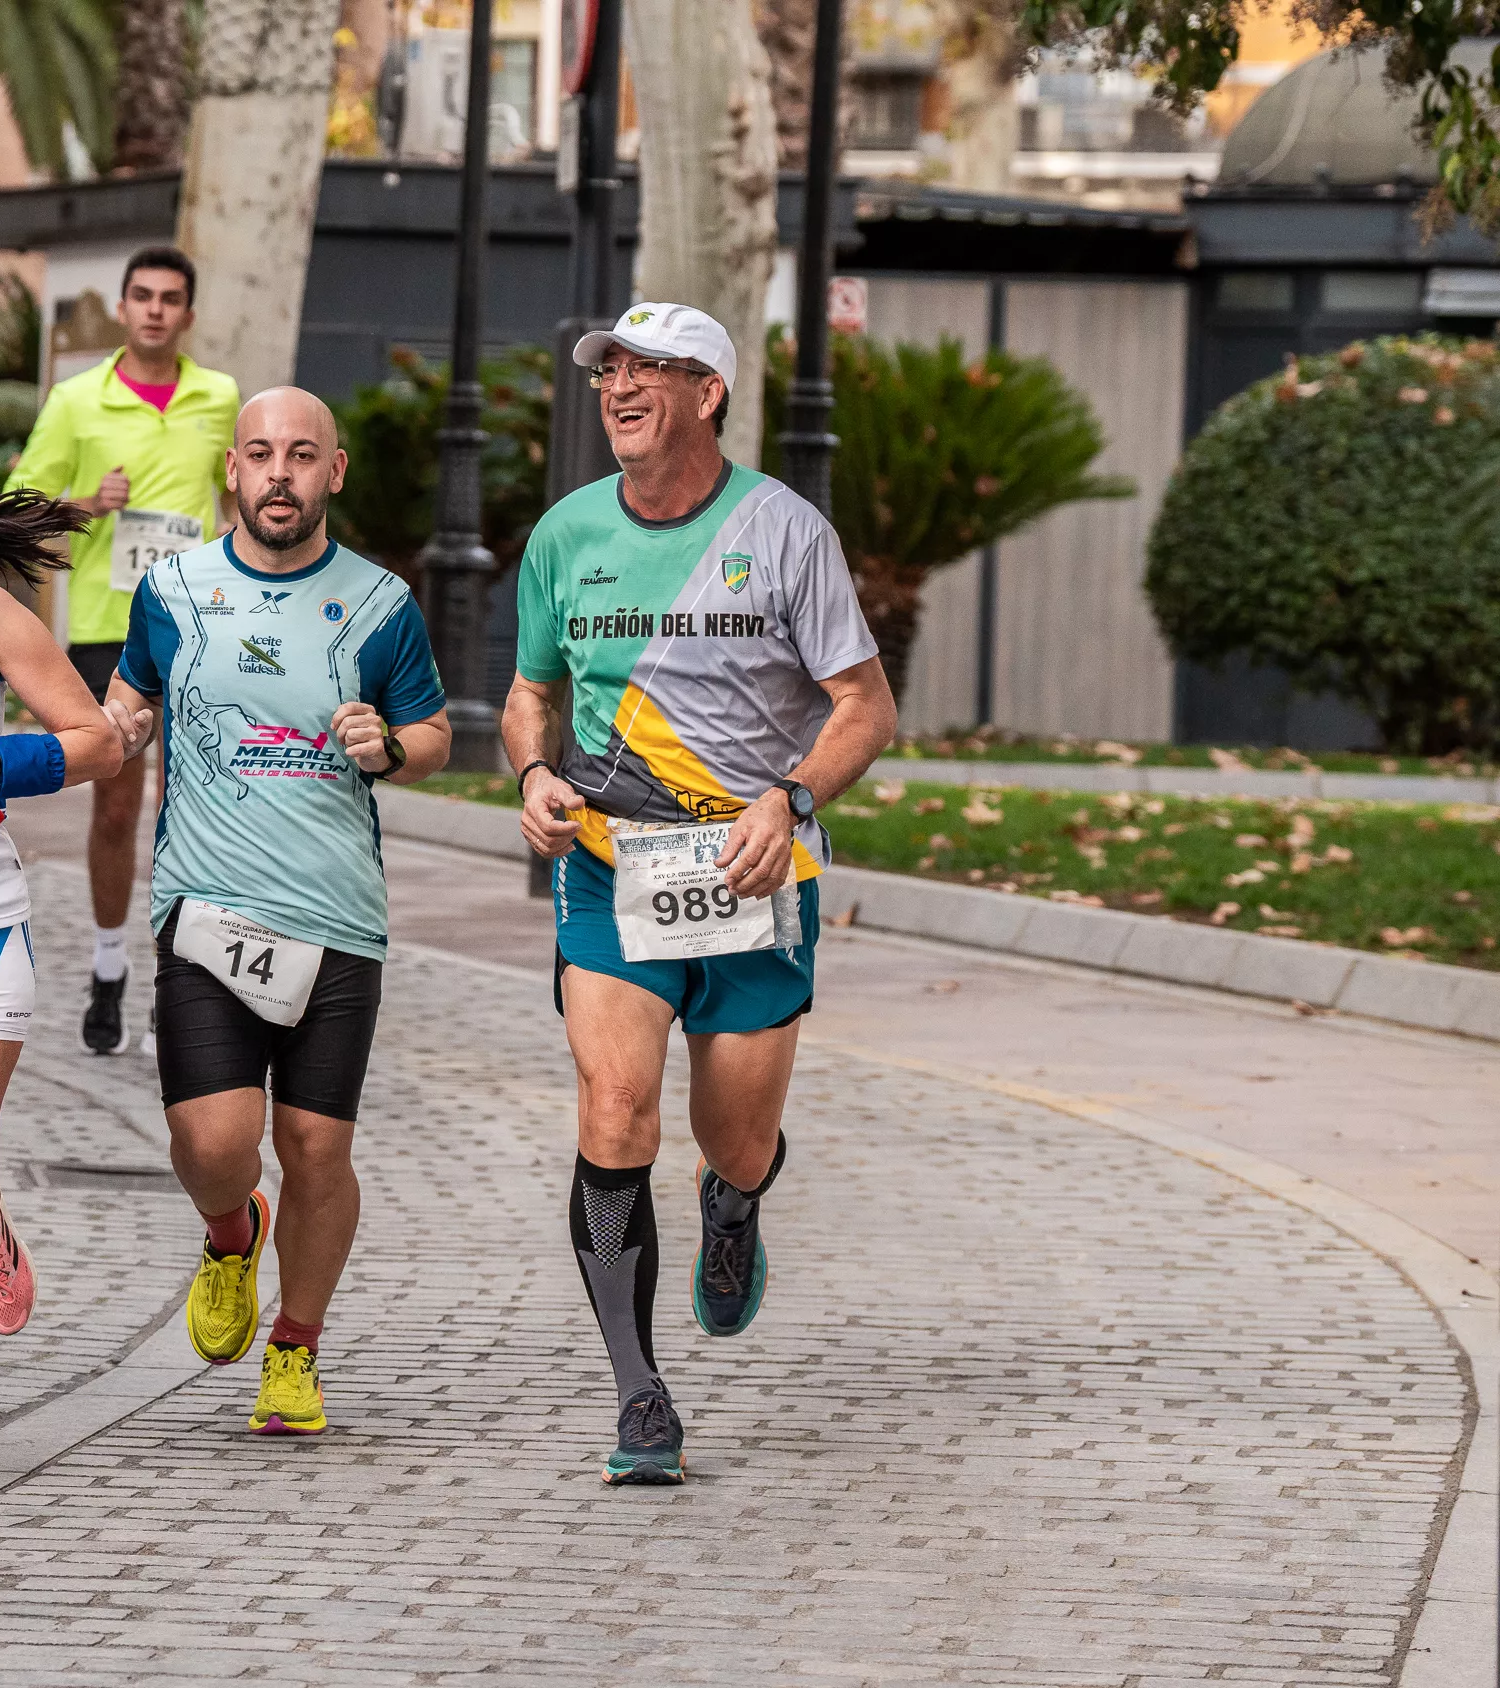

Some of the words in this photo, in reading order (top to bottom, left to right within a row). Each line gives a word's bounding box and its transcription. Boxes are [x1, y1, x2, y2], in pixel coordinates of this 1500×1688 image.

[568, 616, 587, 641] CD
[592, 606, 654, 639] PEÑÓN
[661, 613, 698, 638] DEL
[248, 634, 283, 647] Aceite
[238, 651, 261, 662] Las
[266, 647, 281, 658] de
[237, 662, 286, 676] Valdesas
[240, 724, 329, 751] 34
[228, 758, 350, 773] MARATON
[239, 769, 264, 777] VILLA
[266, 769, 280, 777] DE
[282, 770, 317, 779] PUENTE
[681, 833, 690, 841] DE
[690, 828, 730, 847] 2024
[618, 844, 651, 853] CARRERAS
[652, 840, 691, 850] POPULARES
[678, 870, 699, 878] CIUDAD
[708, 867, 731, 875] LUCENA
[688, 876, 718, 885] IGUALDAD
[652, 883, 739, 926] 989
[232, 922, 242, 930] C.P.
[242, 925, 262, 935] CIUDAD
[270, 931, 292, 941] LUCENA
[240, 931, 248, 939] LA
[248, 934, 277, 944] IGUALDAD
[662, 934, 684, 942] TOMAS
[703, 927, 739, 937] GONZALEZ
[224, 940, 275, 986] 14
[236, 988, 268, 1001] TENLLADO
[268, 997, 293, 1008] ILLANES
